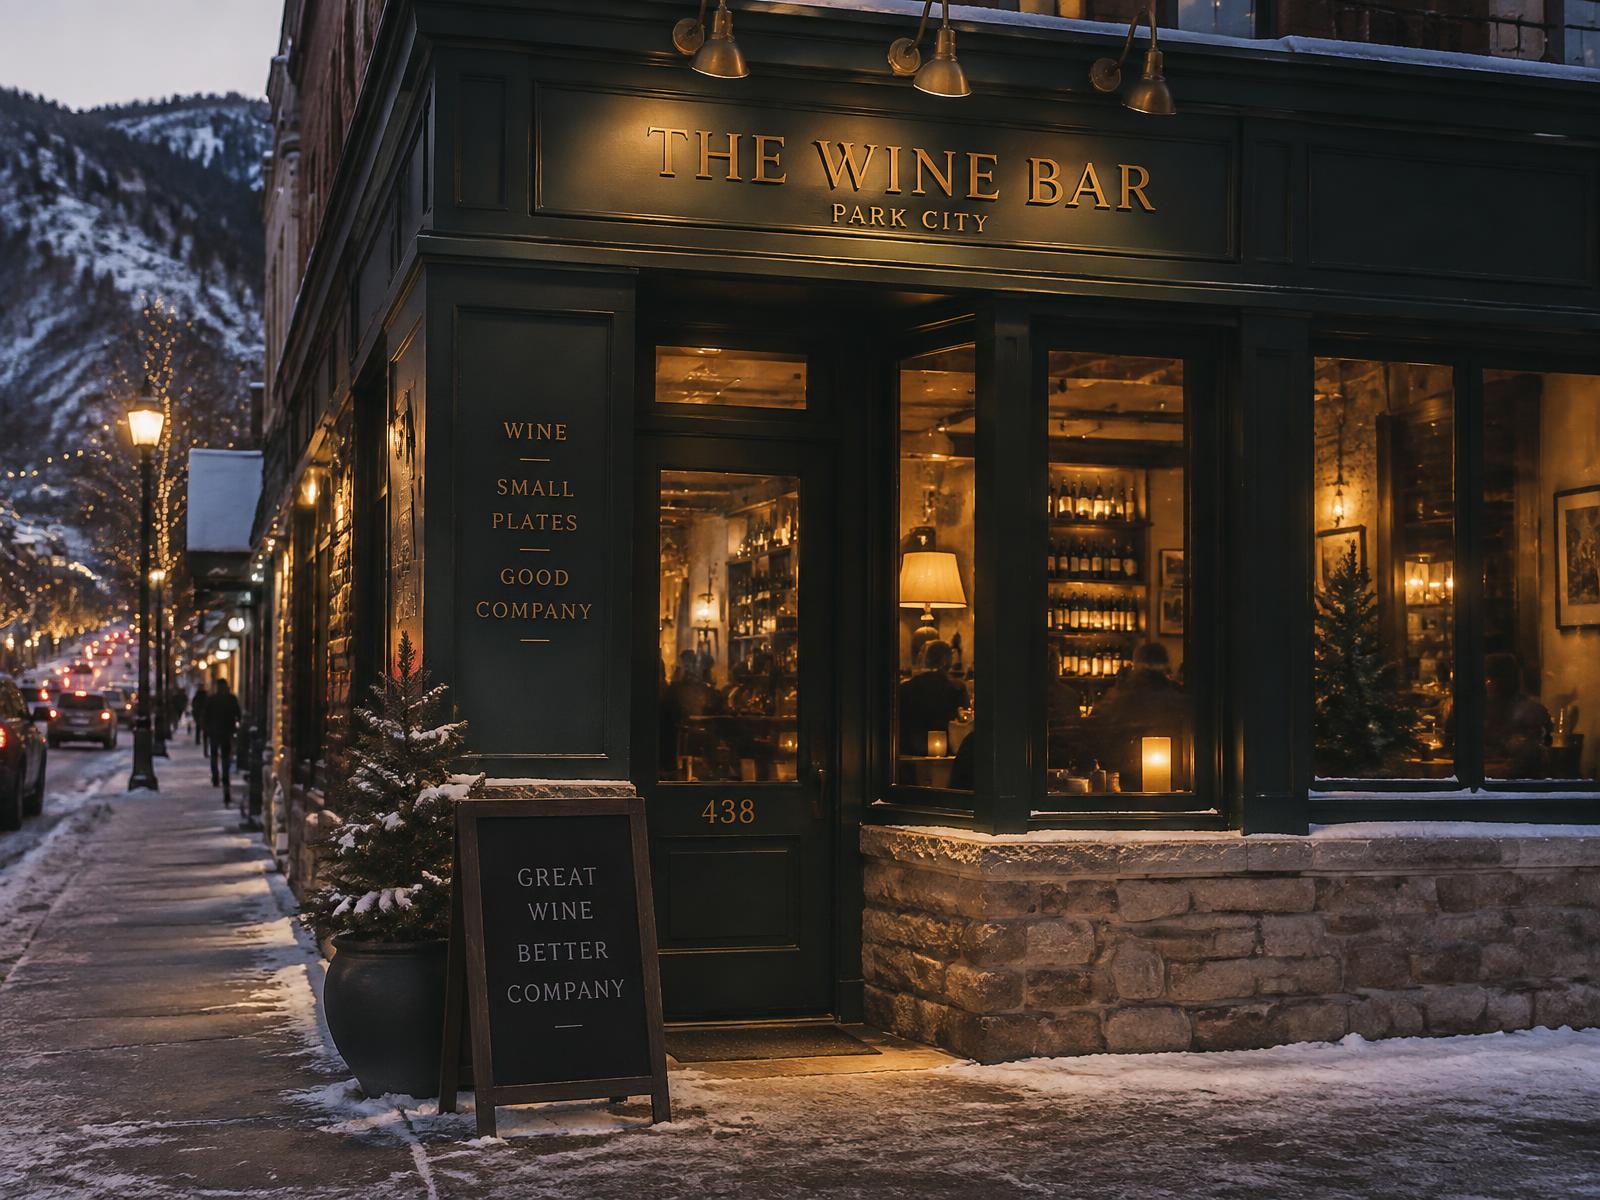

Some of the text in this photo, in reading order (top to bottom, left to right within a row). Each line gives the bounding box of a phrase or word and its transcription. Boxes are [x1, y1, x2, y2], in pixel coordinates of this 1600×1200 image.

[646, 126, 1156, 212] THE WINE BAR
[832, 203, 989, 233] PARK CITY
[503, 421, 567, 441] WINE
[496, 478, 574, 497] SMALL
[492, 512, 577, 531] PLATES
[500, 568, 569, 586] GOOD
[475, 600, 592, 620] COMPANY
[701, 799, 755, 824] 438
[517, 866, 597, 887] GREAT
[527, 901, 594, 921] WINE
[517, 941, 609, 963] BETTER
[507, 979, 625, 1004] COMPANY
